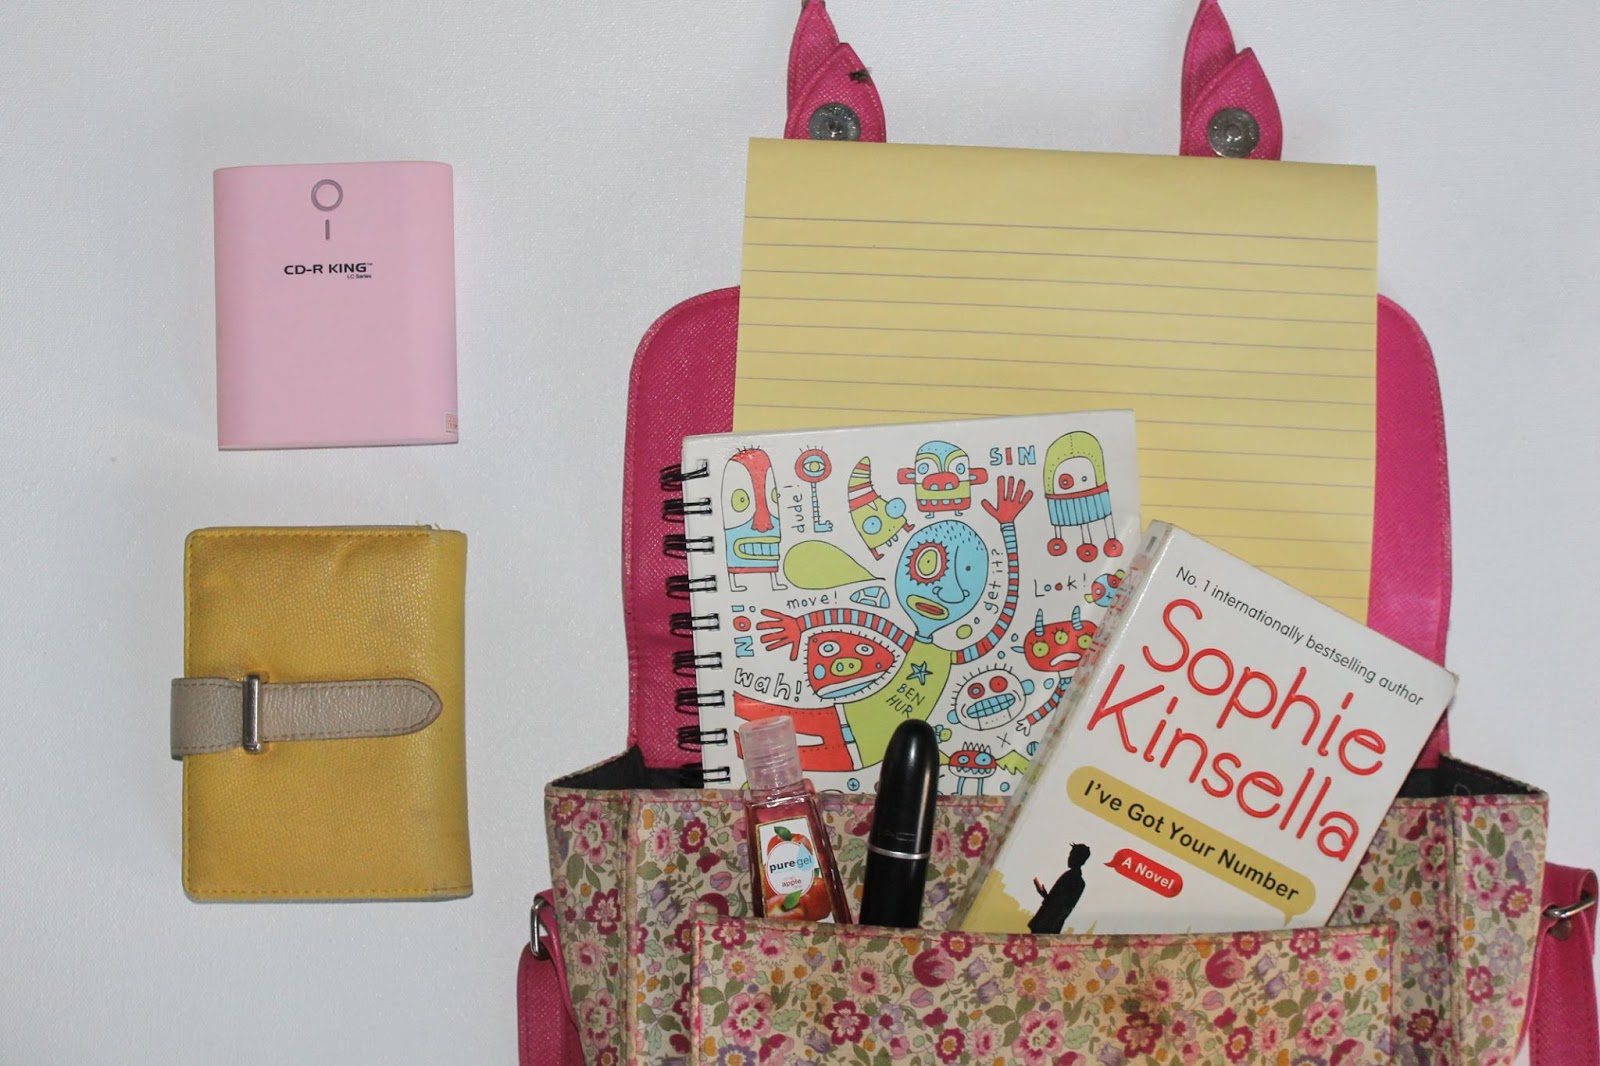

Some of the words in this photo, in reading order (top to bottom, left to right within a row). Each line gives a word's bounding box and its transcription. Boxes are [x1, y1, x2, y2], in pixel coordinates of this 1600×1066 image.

[284, 264, 323, 275] CD-R
[989, 445, 1036, 466] SIN
[783, 484, 805, 533] dude!
[991, 548, 1004, 574] it?
[786, 591, 838, 610] move!
[985, 579, 1001, 615] get
[1176, 566, 1198, 589] No.
[1202, 579, 1211, 593] 1
[1210, 583, 1304, 645] internationally
[1306, 634, 1378, 684] bestselling
[1378, 672, 1425, 706] author
[734, 667, 802, 702] wah!
[896, 683, 926, 706] BEN
[1142, 598, 1386, 776] Sophie
[886, 695, 914, 718] HUR
[1086, 663, 1359, 862] Kinsella
[1084, 779, 1122, 811] I've
[1127, 802, 1164, 834] Got
[1170, 822, 1215, 858] Your
[1217, 849, 1299, 901] Number
[781, 879, 802, 888] apple
[1121, 856, 1133, 869] A
[1135, 862, 1175, 890] Novel
